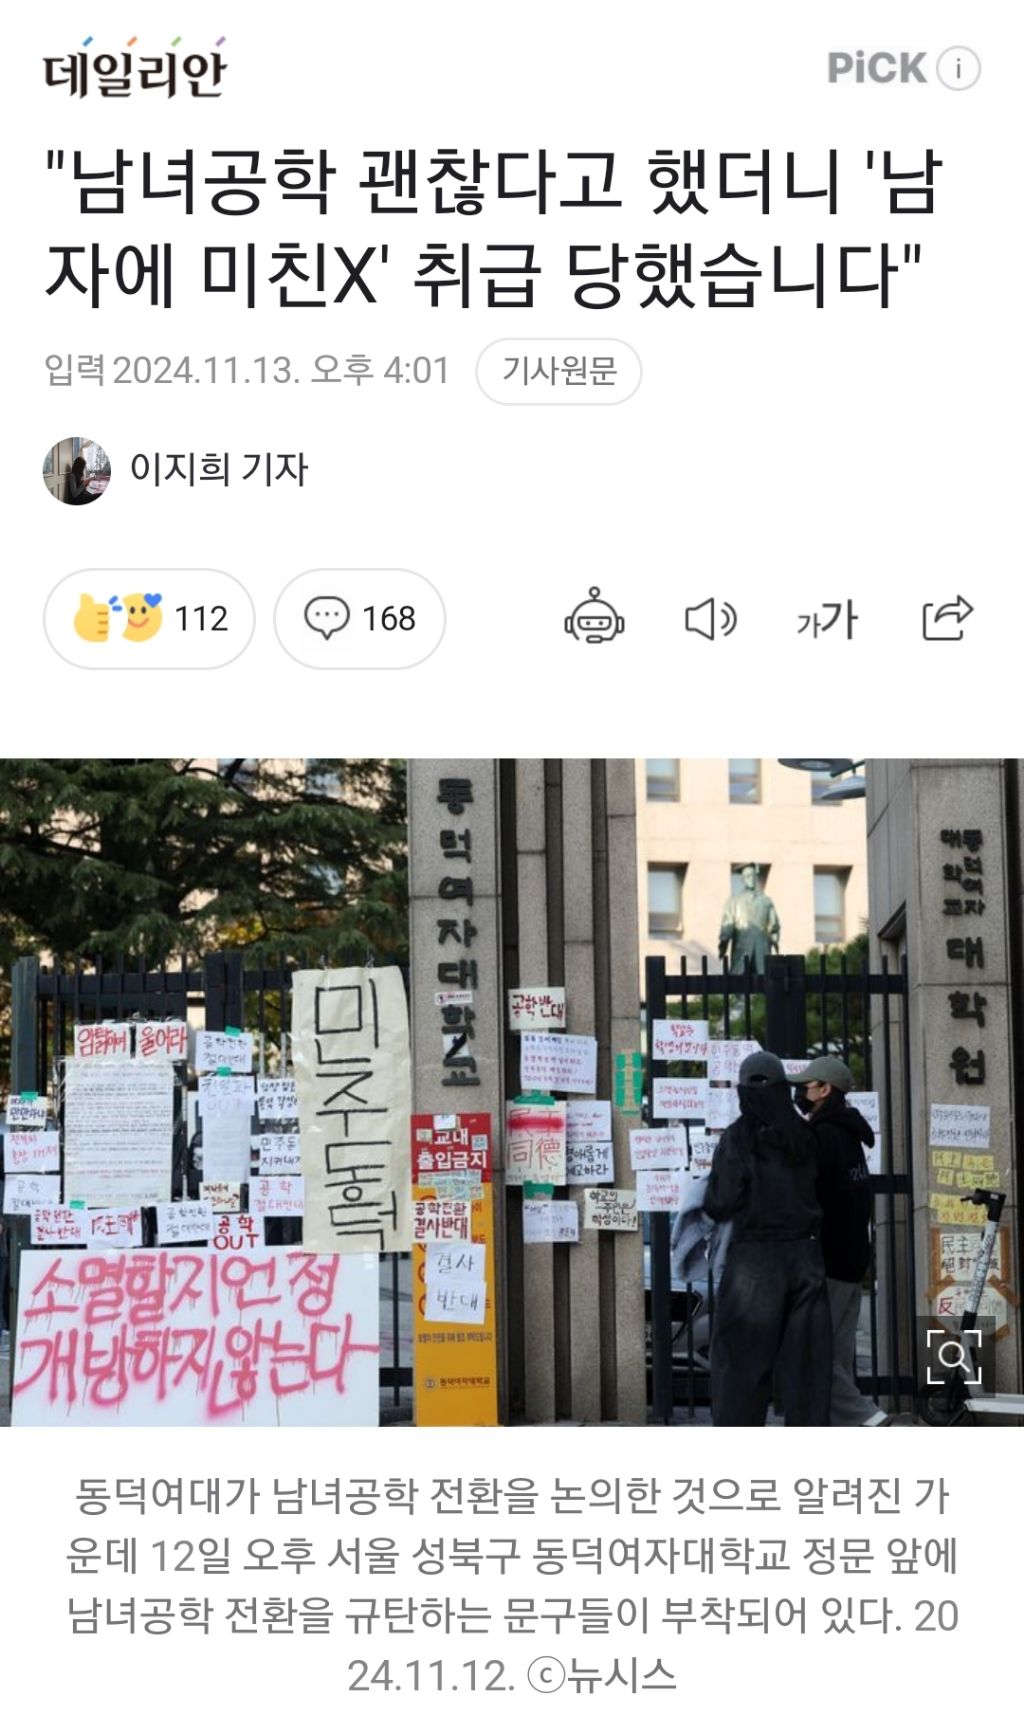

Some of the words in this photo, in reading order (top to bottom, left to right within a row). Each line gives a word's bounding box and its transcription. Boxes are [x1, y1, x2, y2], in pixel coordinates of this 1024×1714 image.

[138, 1025, 188, 1058] 울어라
[315, 978, 397, 1251] 민주동덕
[433, 1127, 469, 1145] 교내
[417, 1151, 487, 1169] 출입금지
[218, 1216, 253, 1234] 공학
[213, 1234, 259, 1250] OUT
